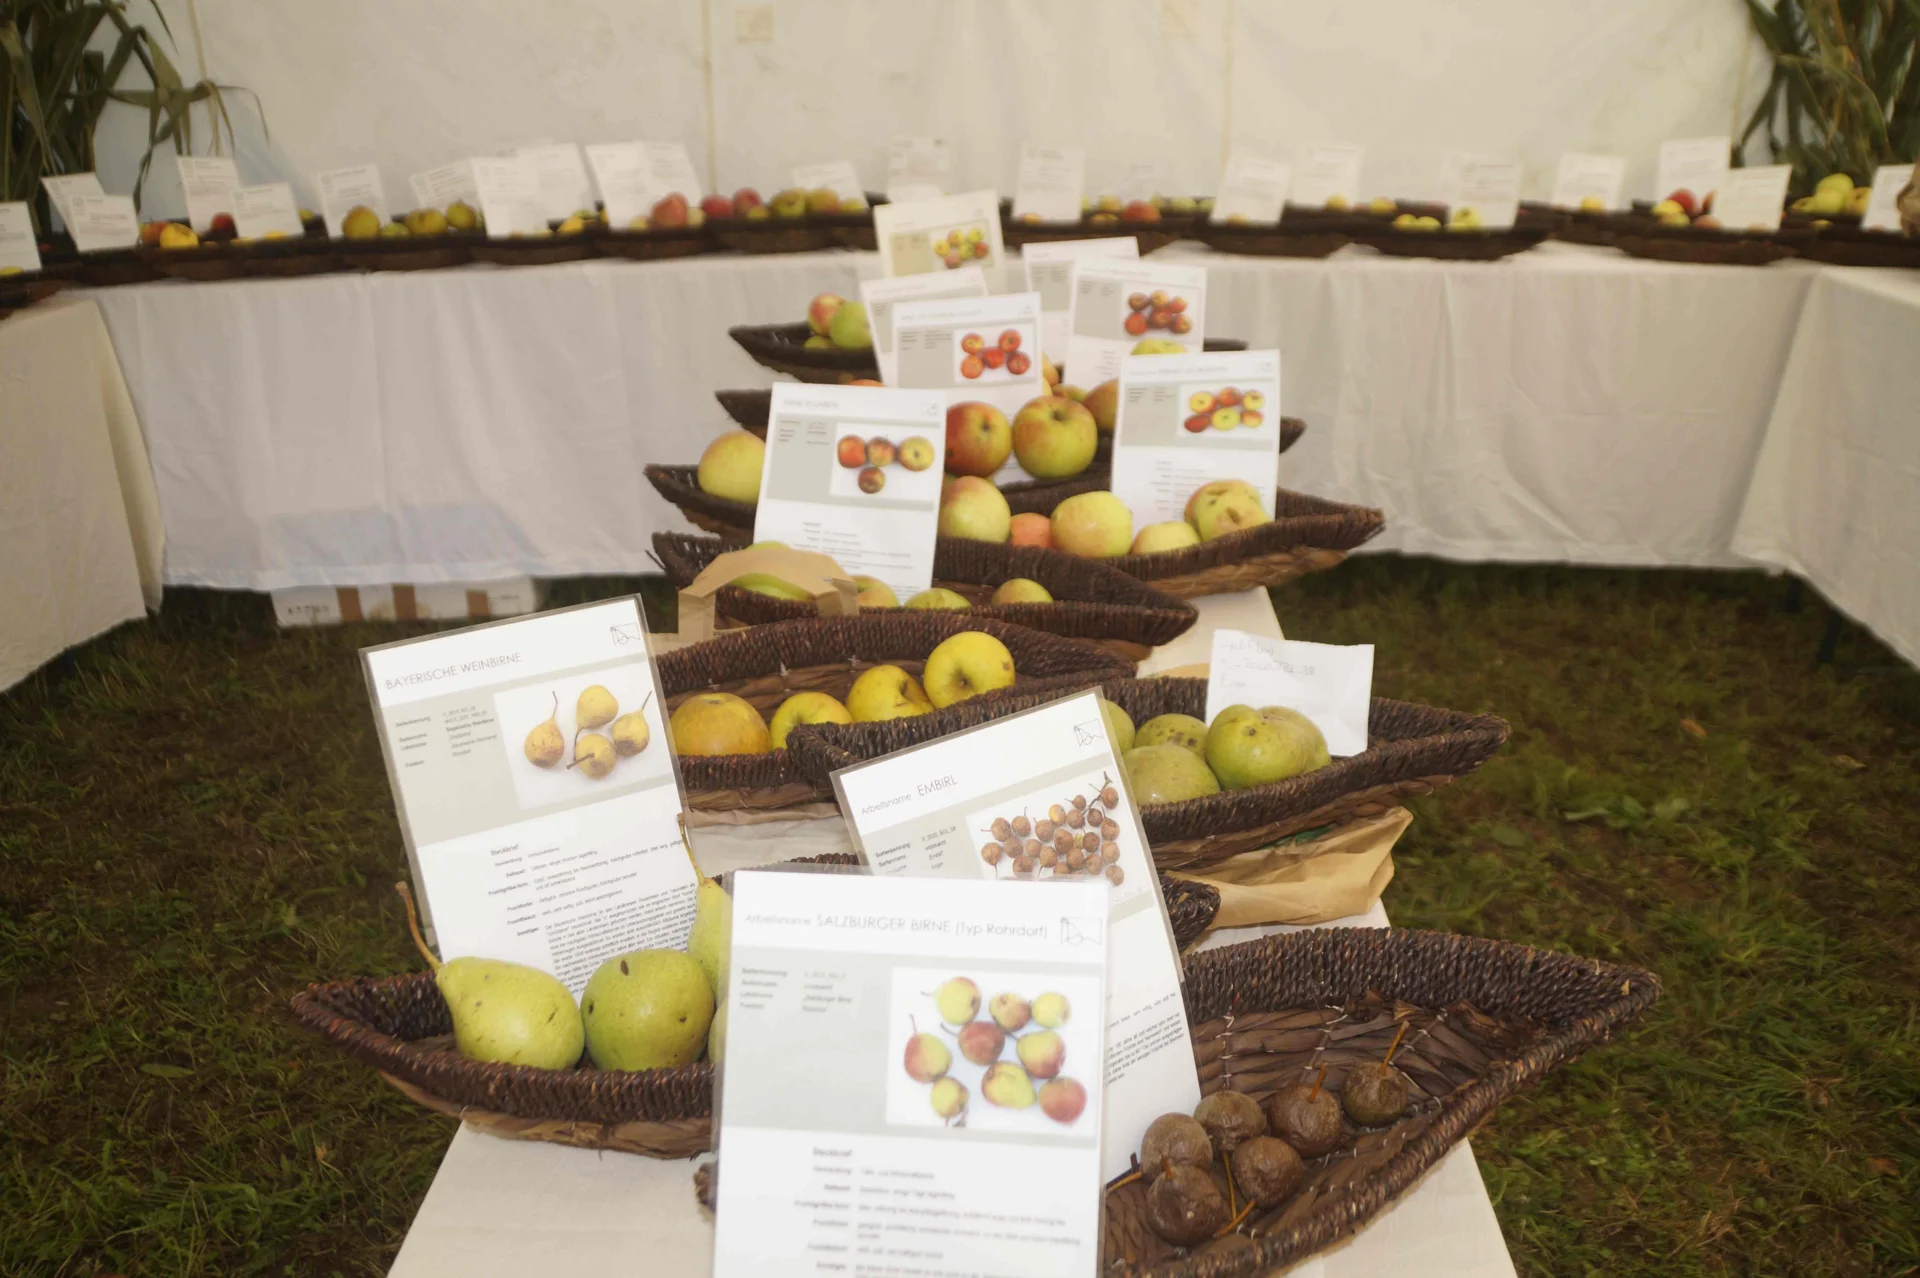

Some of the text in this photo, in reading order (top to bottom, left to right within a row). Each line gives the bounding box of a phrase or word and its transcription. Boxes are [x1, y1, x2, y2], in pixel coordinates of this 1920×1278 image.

[385, 652, 522, 689] BAYERISCHE WEINBIRNE
[861, 774, 957, 815] Arbeitsname EMBIRL
[744, 912, 1048, 939] Arbeitsname SALZBURGER BIRNE (Typ Rohrdorf)
